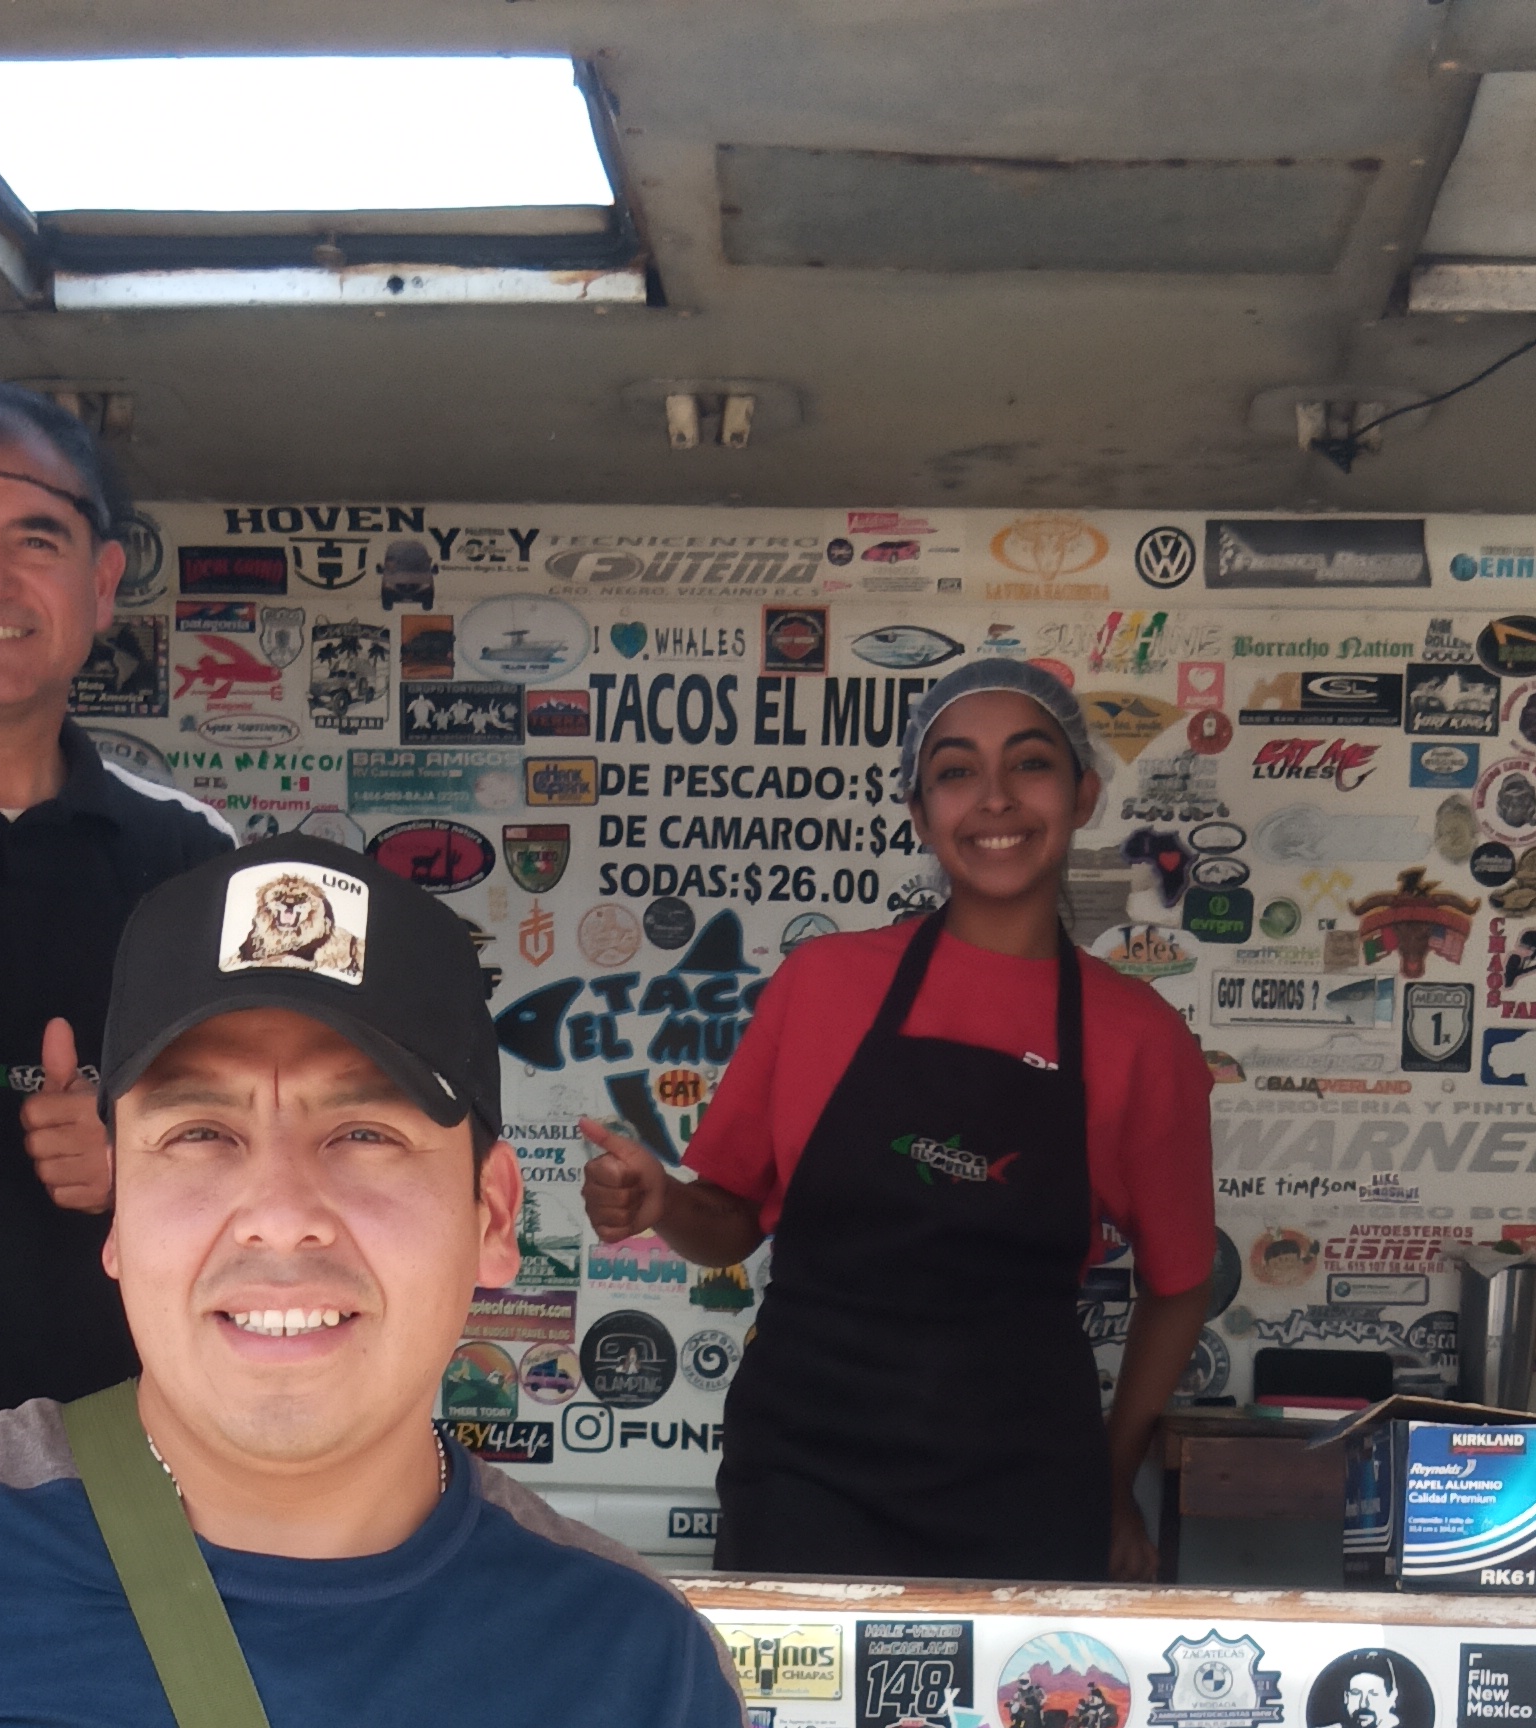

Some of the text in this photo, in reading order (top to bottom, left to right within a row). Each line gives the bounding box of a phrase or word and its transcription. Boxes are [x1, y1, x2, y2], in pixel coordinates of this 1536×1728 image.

[223, 506, 426, 535] HOVEN
[544, 535, 820, 548] TECNICENTRO
[179, 618, 251, 633] patagonia
[654, 626, 747, 657] WHALES
[1231, 635, 1415, 660] Borracho Nation
[589, 673, 807, 746] TACOS EL
[166, 750, 224, 771] VIVA
[351, 752, 521, 767] BAJA AMIGOS
[600, 762, 650, 797] DE
[1252, 764, 1334, 781] LURES
[598, 814, 648, 849] DE
[322, 873, 362, 896] LION
[1217, 976, 1307, 1012] GOT CEDROS
[1413, 990, 1464, 1005] MEXICO
[566, 1011, 633, 1063] EL
[658, 1080, 701, 1099] CAT
[1214, 1100, 1412, 1117] CARROCERIA
[1419, 1101, 1441, 1116] Y
[1217, 1176, 1267, 1199] ZANE
[1349, 1223, 1474, 1239] AUTOESTEREOS
[588, 1243, 688, 1284] BAJA
[448, 1407, 512, 1417] THERE TODAY
[1452, 1433, 1525, 1447] KIRKLAND
[1409, 1461, 1464, 1478] Reynolds
[1408, 1479, 1504, 1491] PAPEL ALUMINIO
[1408, 1491, 1498, 1505] Calidad Premium
[1181, 1647, 1246, 1661] ZACATECAS
[781, 1669, 835, 1682] CHIAPAS
[1466, 1668, 1510, 1687] Film
[1466, 1685, 1510, 1702] New
[1466, 1701, 1534, 1720] Mexico
